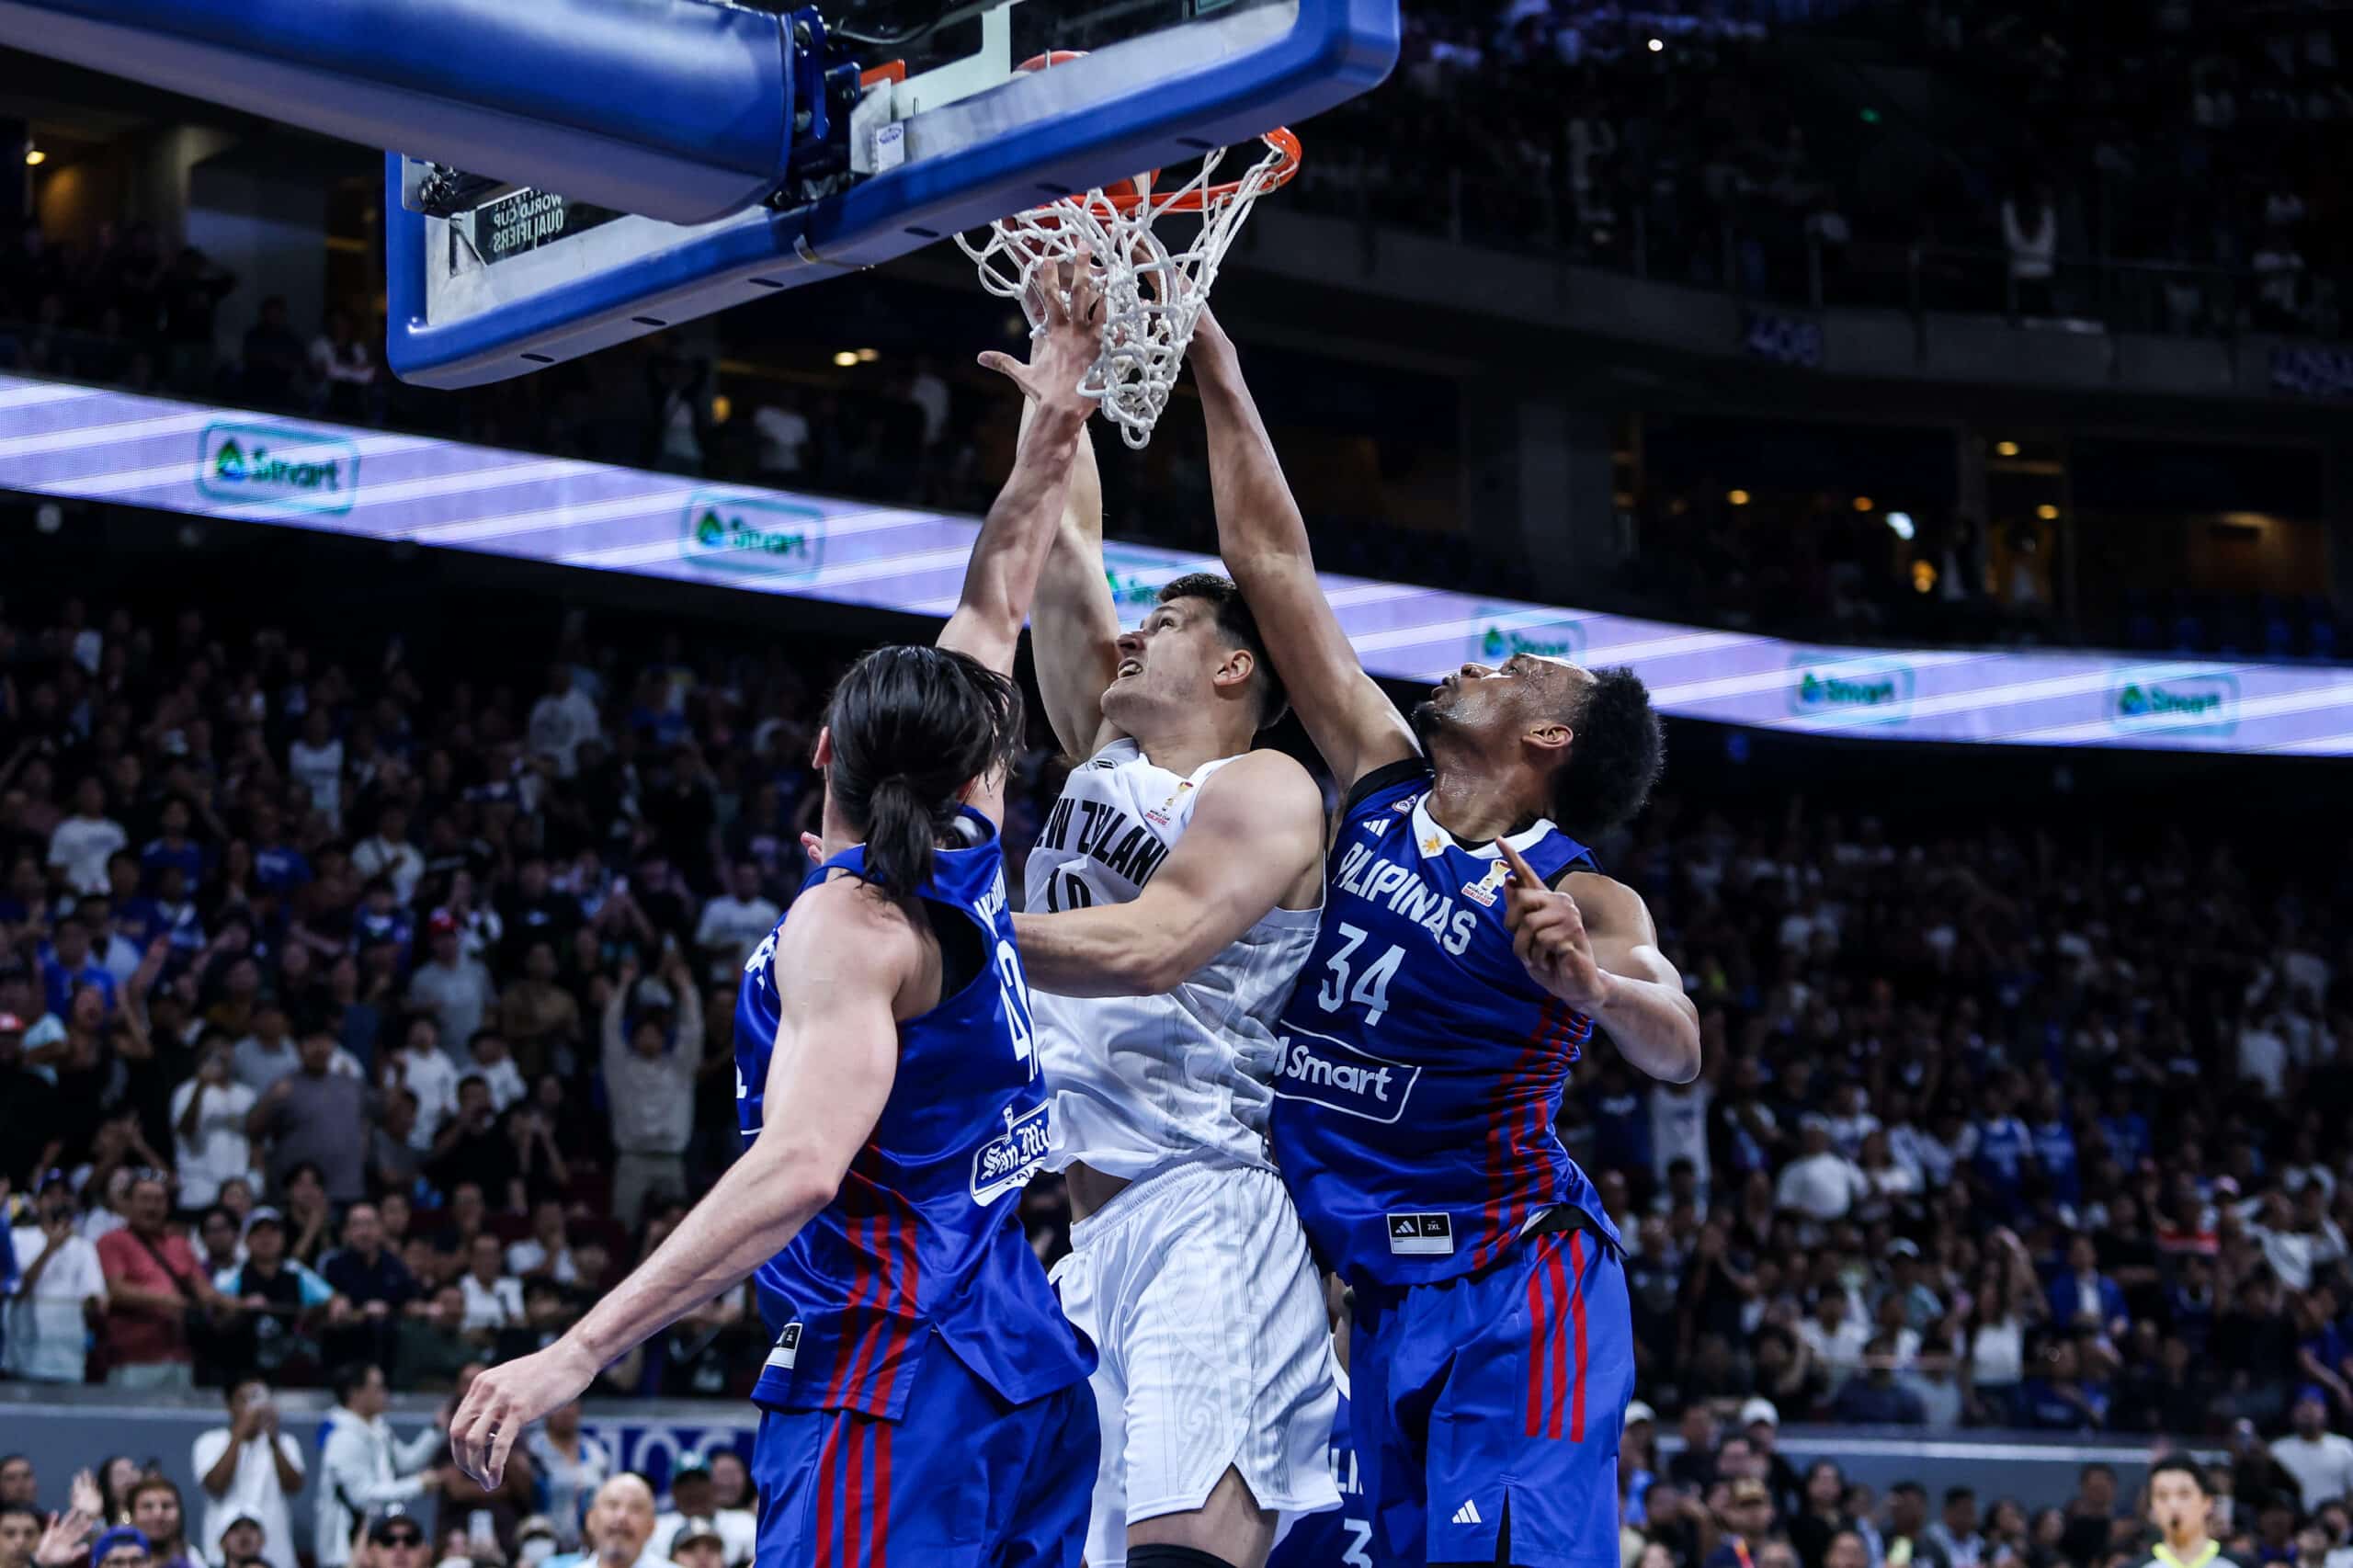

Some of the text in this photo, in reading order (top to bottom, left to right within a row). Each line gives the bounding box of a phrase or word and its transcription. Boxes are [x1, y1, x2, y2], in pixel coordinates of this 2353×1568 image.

[250, 445, 339, 492] Smart
[1317, 921, 1407, 1028] 34
[1287, 1044, 1394, 1102] Smart
[981, 1144, 1019, 1180] San
